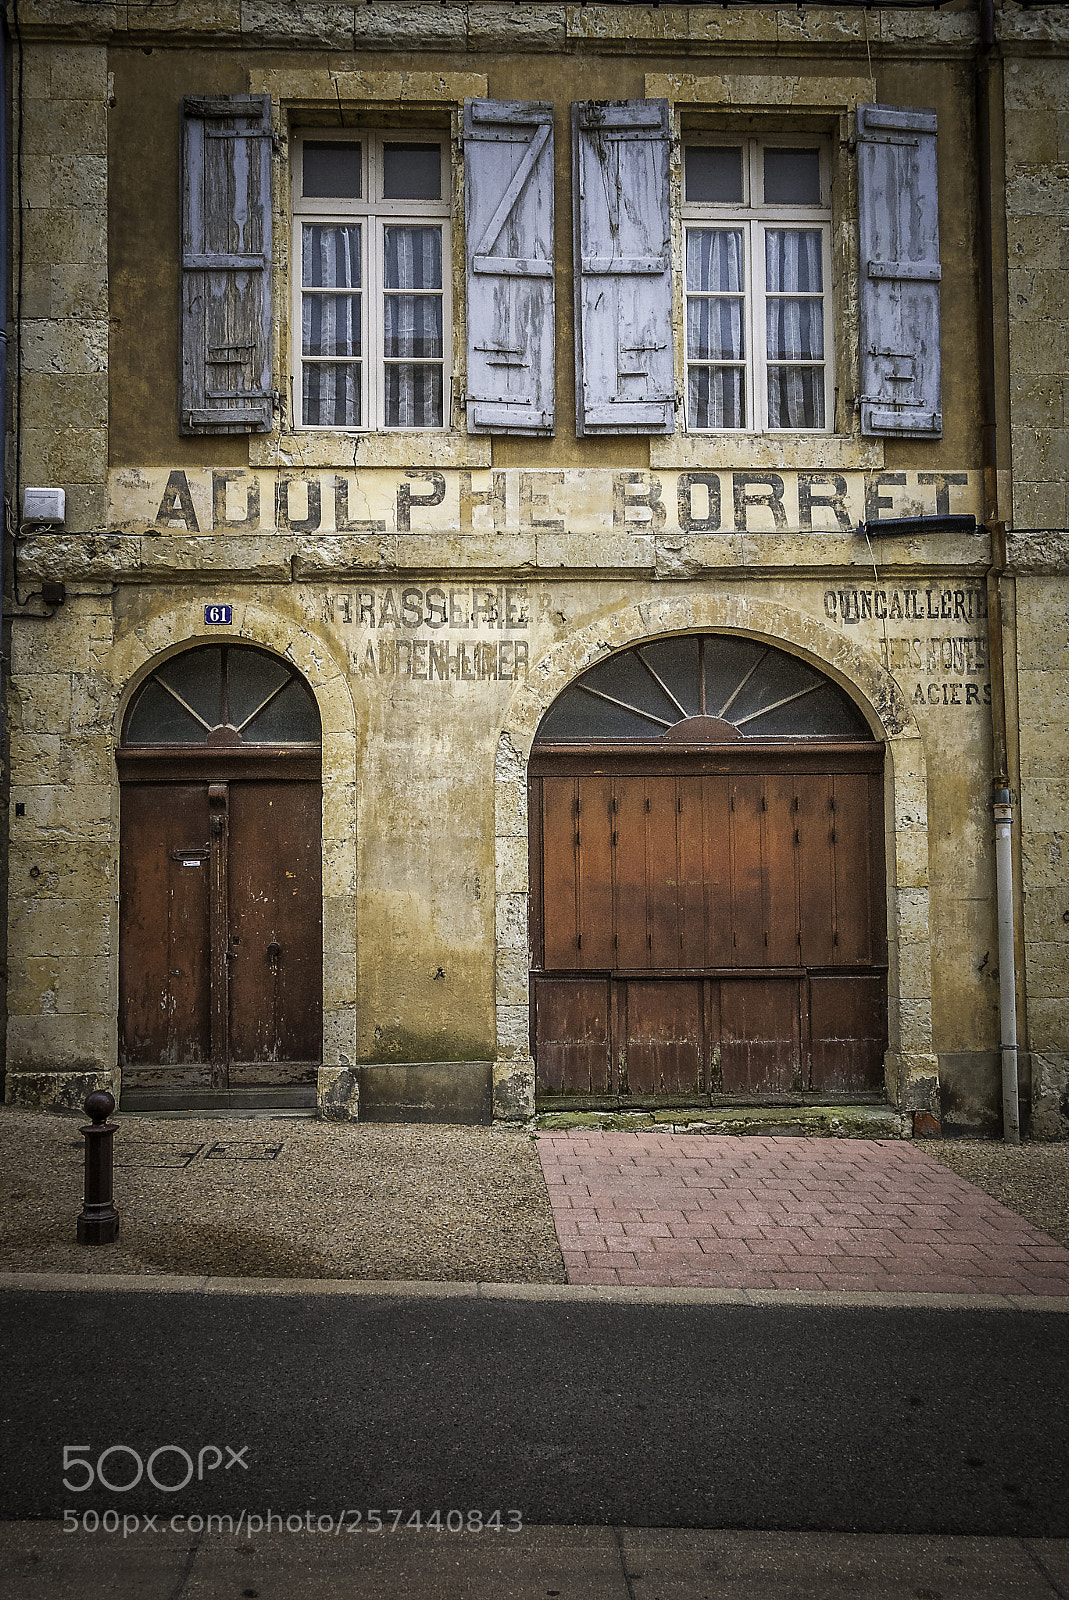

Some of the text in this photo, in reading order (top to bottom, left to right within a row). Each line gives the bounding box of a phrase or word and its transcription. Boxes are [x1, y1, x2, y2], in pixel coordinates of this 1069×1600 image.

[155, 470, 968, 532] ADOLPHE BORRET
[210, 606, 227, 622] 61
[914, 683, 992, 705] ACIERS
